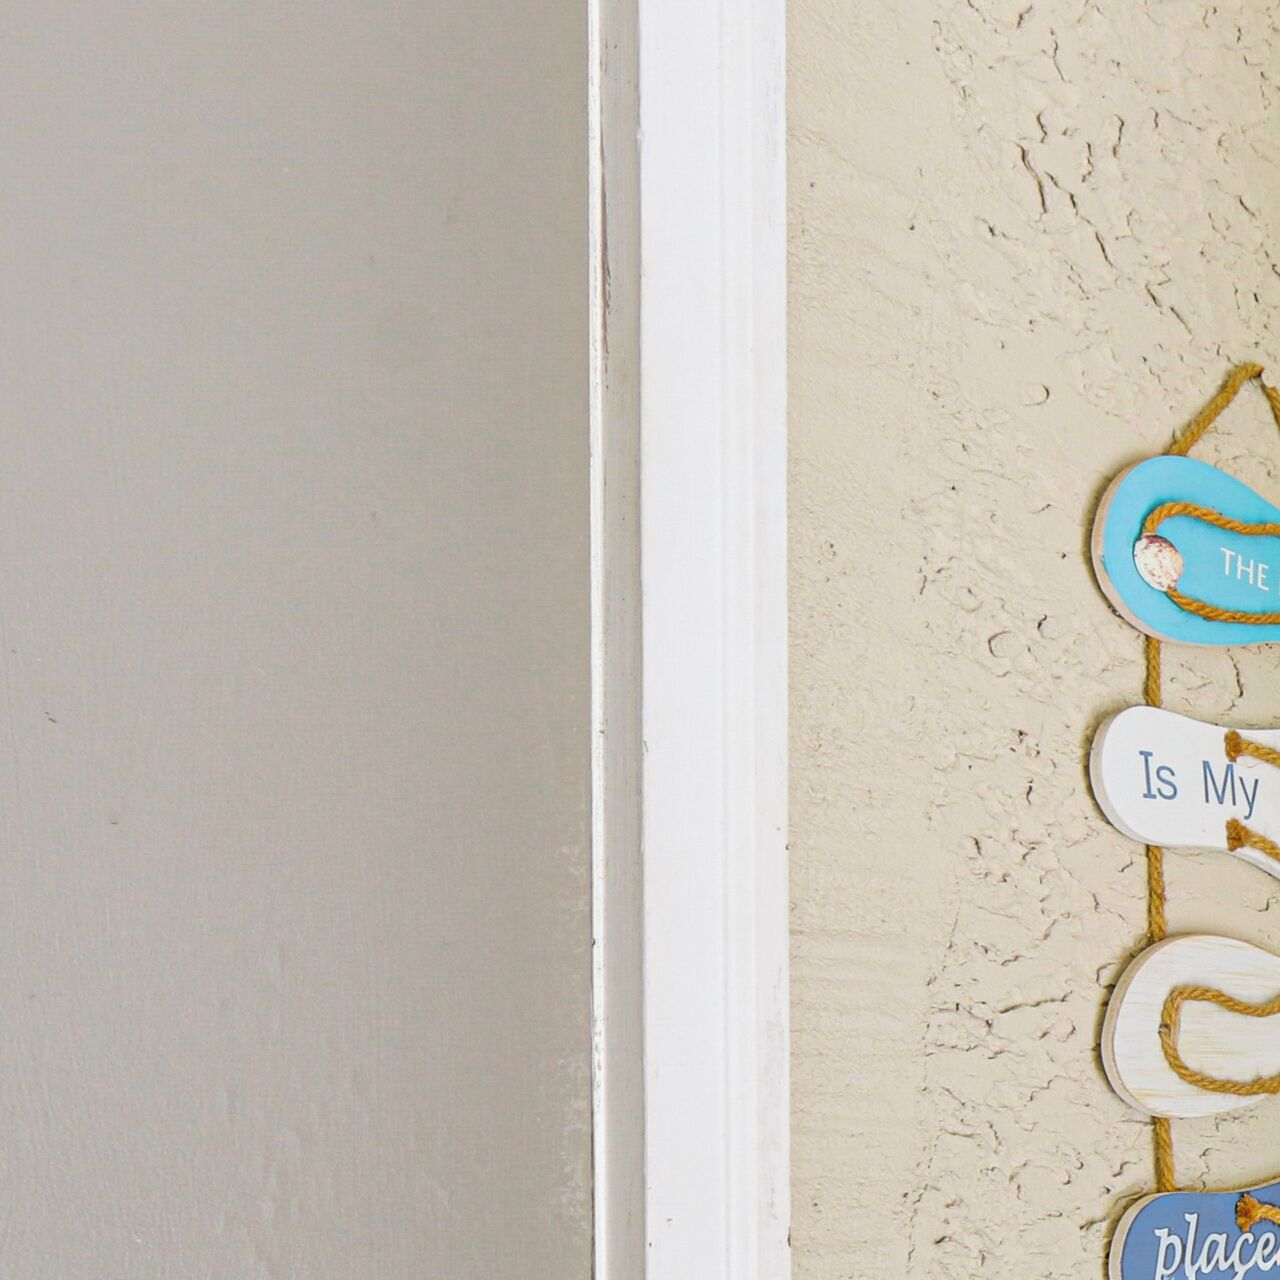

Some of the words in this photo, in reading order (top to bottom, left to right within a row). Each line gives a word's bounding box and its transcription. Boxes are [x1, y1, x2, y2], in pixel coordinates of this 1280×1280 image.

[1219, 546, 1270, 592] THE
[1138, 750, 1179, 801] Is
[1201, 759, 1260, 821] My
